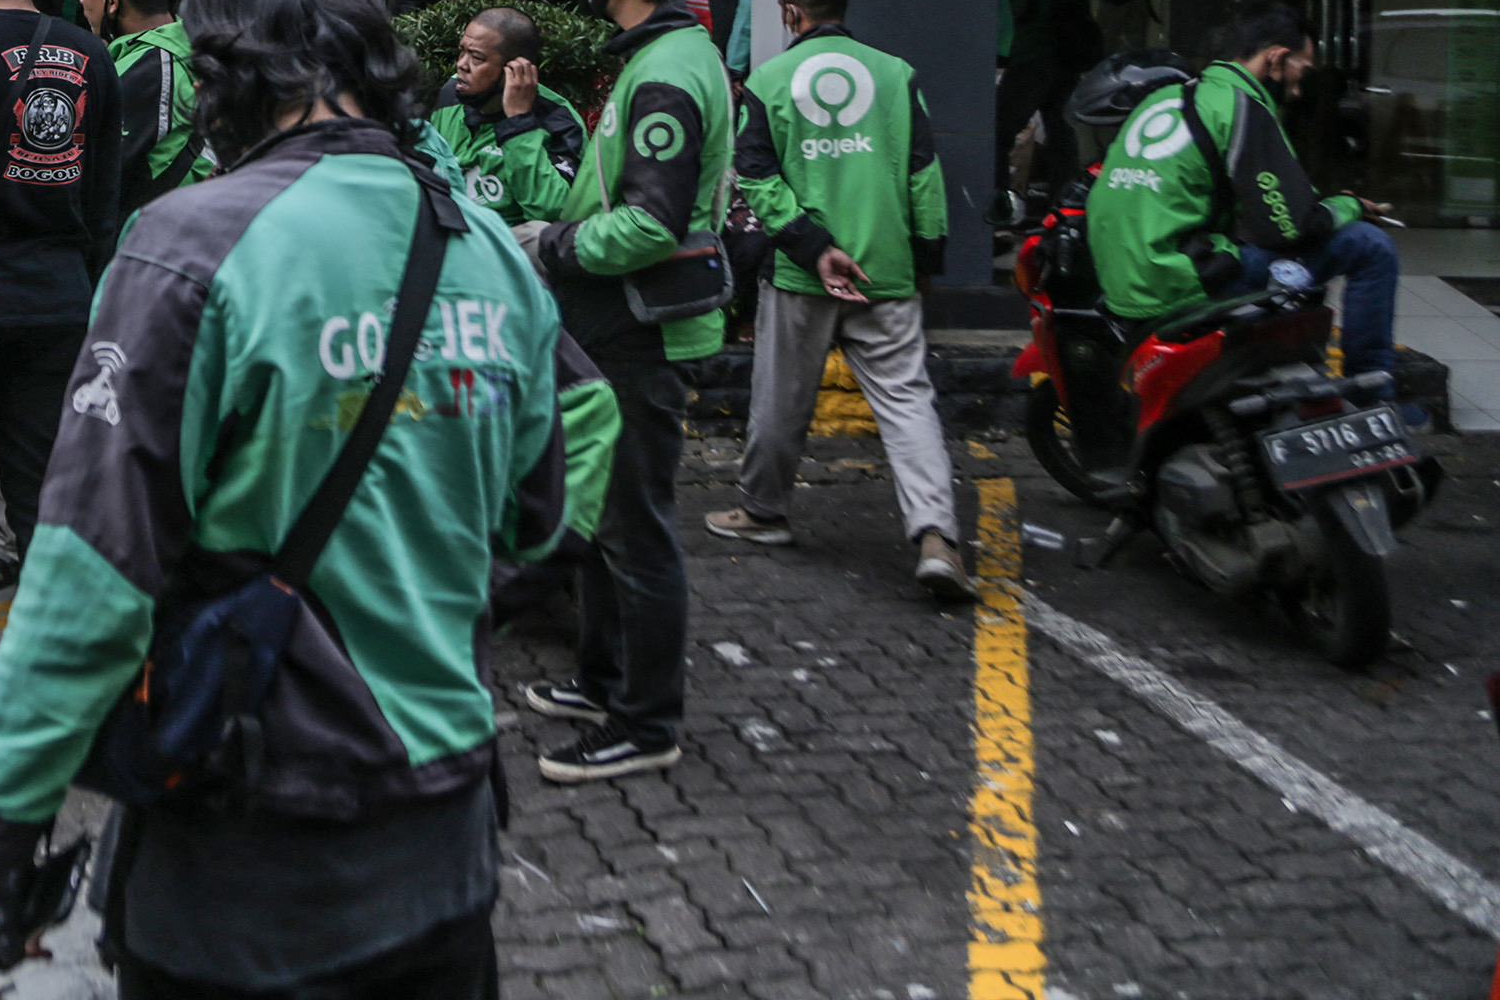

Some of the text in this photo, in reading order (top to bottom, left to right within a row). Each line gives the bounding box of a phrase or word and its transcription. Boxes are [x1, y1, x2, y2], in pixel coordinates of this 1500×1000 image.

[801, 132, 874, 160] gojek
[7, 165, 81, 182] BOGOR
[1107, 167, 1164, 194] gojek
